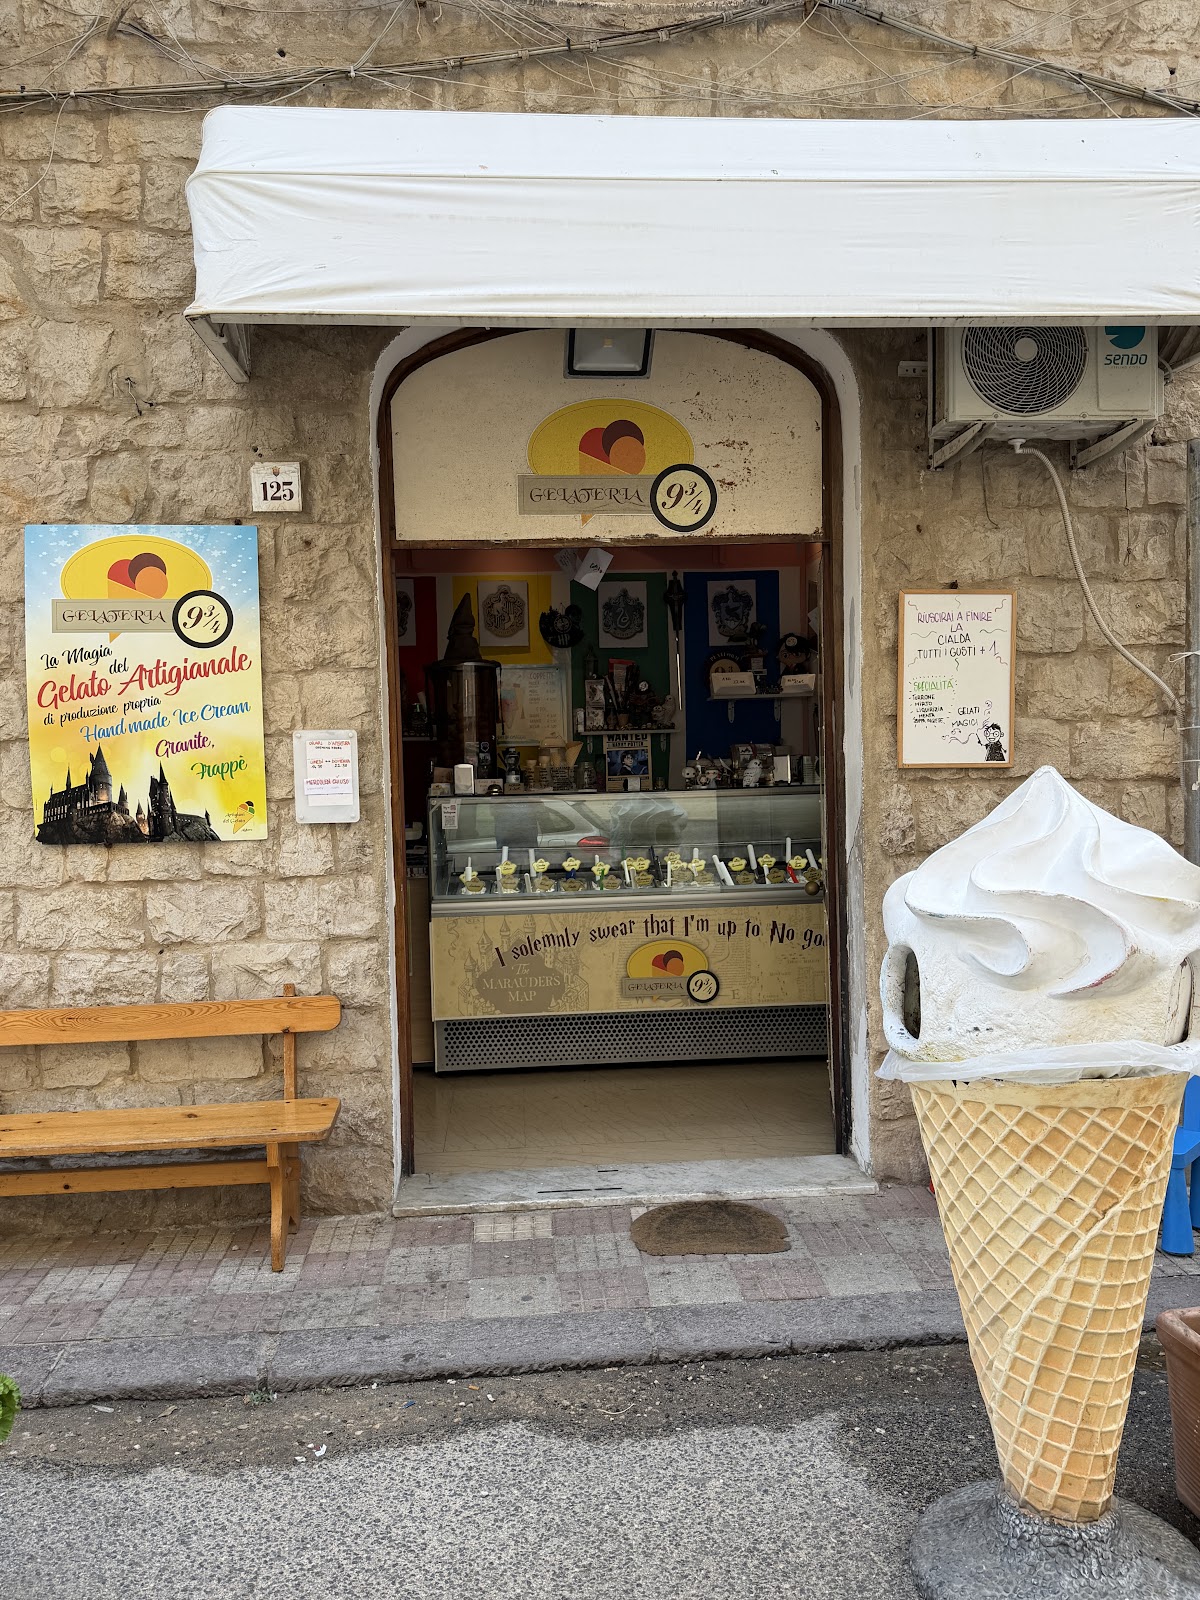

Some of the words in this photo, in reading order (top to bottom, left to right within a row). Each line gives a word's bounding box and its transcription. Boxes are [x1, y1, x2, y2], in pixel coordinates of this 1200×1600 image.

[260, 481, 294, 502] 125
[530, 486, 646, 504] GELATERIA
[62, 608, 168, 624] GELATERIA
[956, 612, 964, 622] A
[966, 610, 992, 622] FINIRE
[950, 622, 964, 633] LA
[938, 632, 972, 646] CIALDA
[40, 653, 60, 671] La
[62, 644, 113, 668] Magia
[918, 646, 942, 659] TUTTI
[950, 645, 976, 658] GUSTI
[108, 658, 129, 676] del
[37, 669, 112, 709] Gelato
[118, 645, 253, 696] Artigianale
[44, 712, 56, 726] di
[60, 703, 118, 726] produzione
[123, 696, 162, 720] propria
[173, 707, 199, 726] Ice
[200, 700, 252, 722] Cream
[958, 706, 980, 716] GELATI
[952, 718, 978, 728] MAGICI
[155, 731, 216, 758] Granite,
[607, 734, 648, 742] WANTED
[190, 756, 248, 780] Frappè
[494, 947, 506, 968] I
[511, 926, 580, 960] solemnly
[589, 918, 636, 942] swear
[643, 914, 675, 938] that
[684, 914, 710, 936] I'm
[718, 920, 737, 942] up
[745, 918, 760, 938] to
[770, 920, 795, 946] No
[512, 963, 530, 976] The
[482, 974, 560, 990] MARAUDER'S
[628, 982, 684, 992] GELATERIA
[508, 991, 537, 1002] MAP
